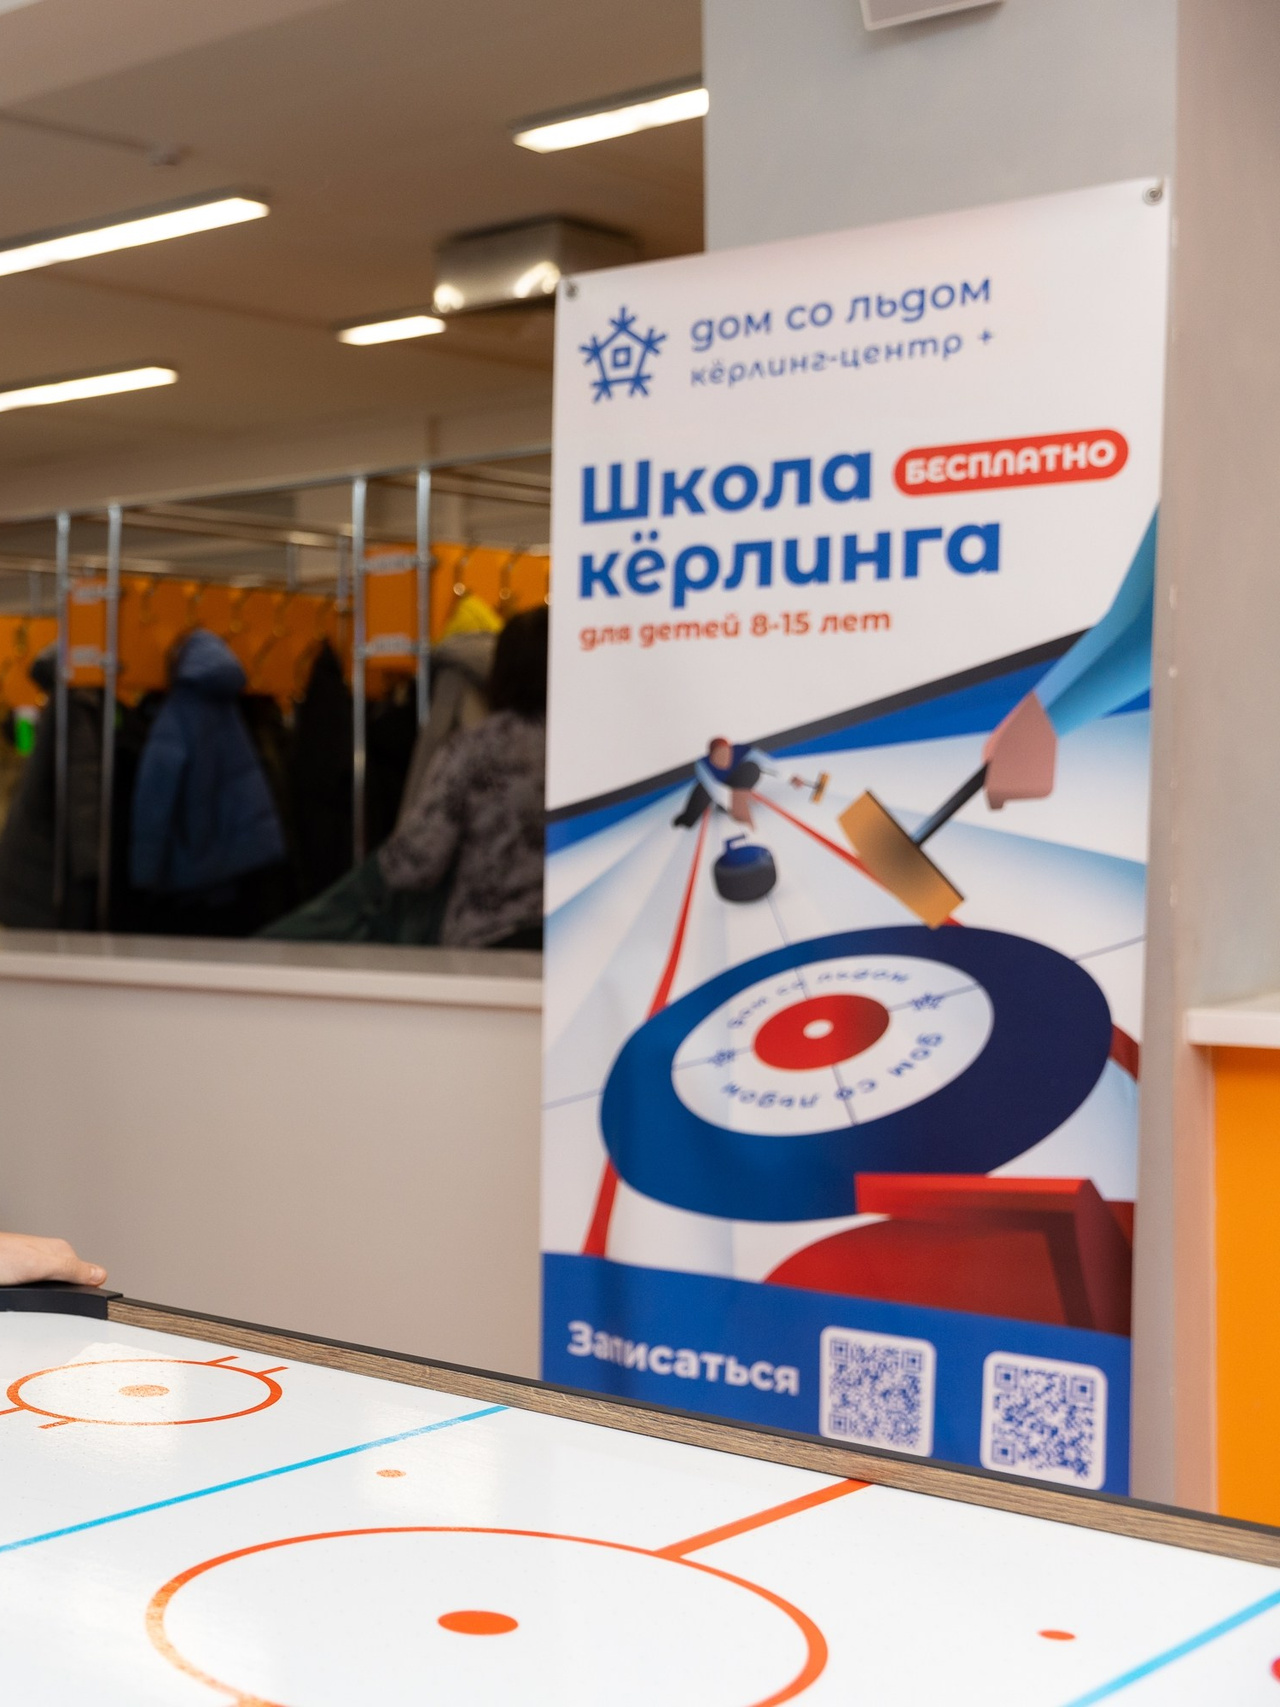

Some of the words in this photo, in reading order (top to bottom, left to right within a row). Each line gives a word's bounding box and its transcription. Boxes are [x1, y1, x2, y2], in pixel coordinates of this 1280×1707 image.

[690, 308, 772, 352] дом
[786, 302, 832, 329] со
[846, 277, 992, 325] льдом
[690, 332, 963, 388] кёрлинг-центр
[580, 450, 872, 525] Школа
[904, 440, 1117, 485] БЕСПЛАТНО
[578, 521, 1002, 608] кёрлинга
[579, 624, 631, 650] для
[638, 614, 740, 647] детей
[749, 611, 810, 636] 8-15
[818, 609, 892, 635] лет
[567, 1320, 801, 1397] Записаться
